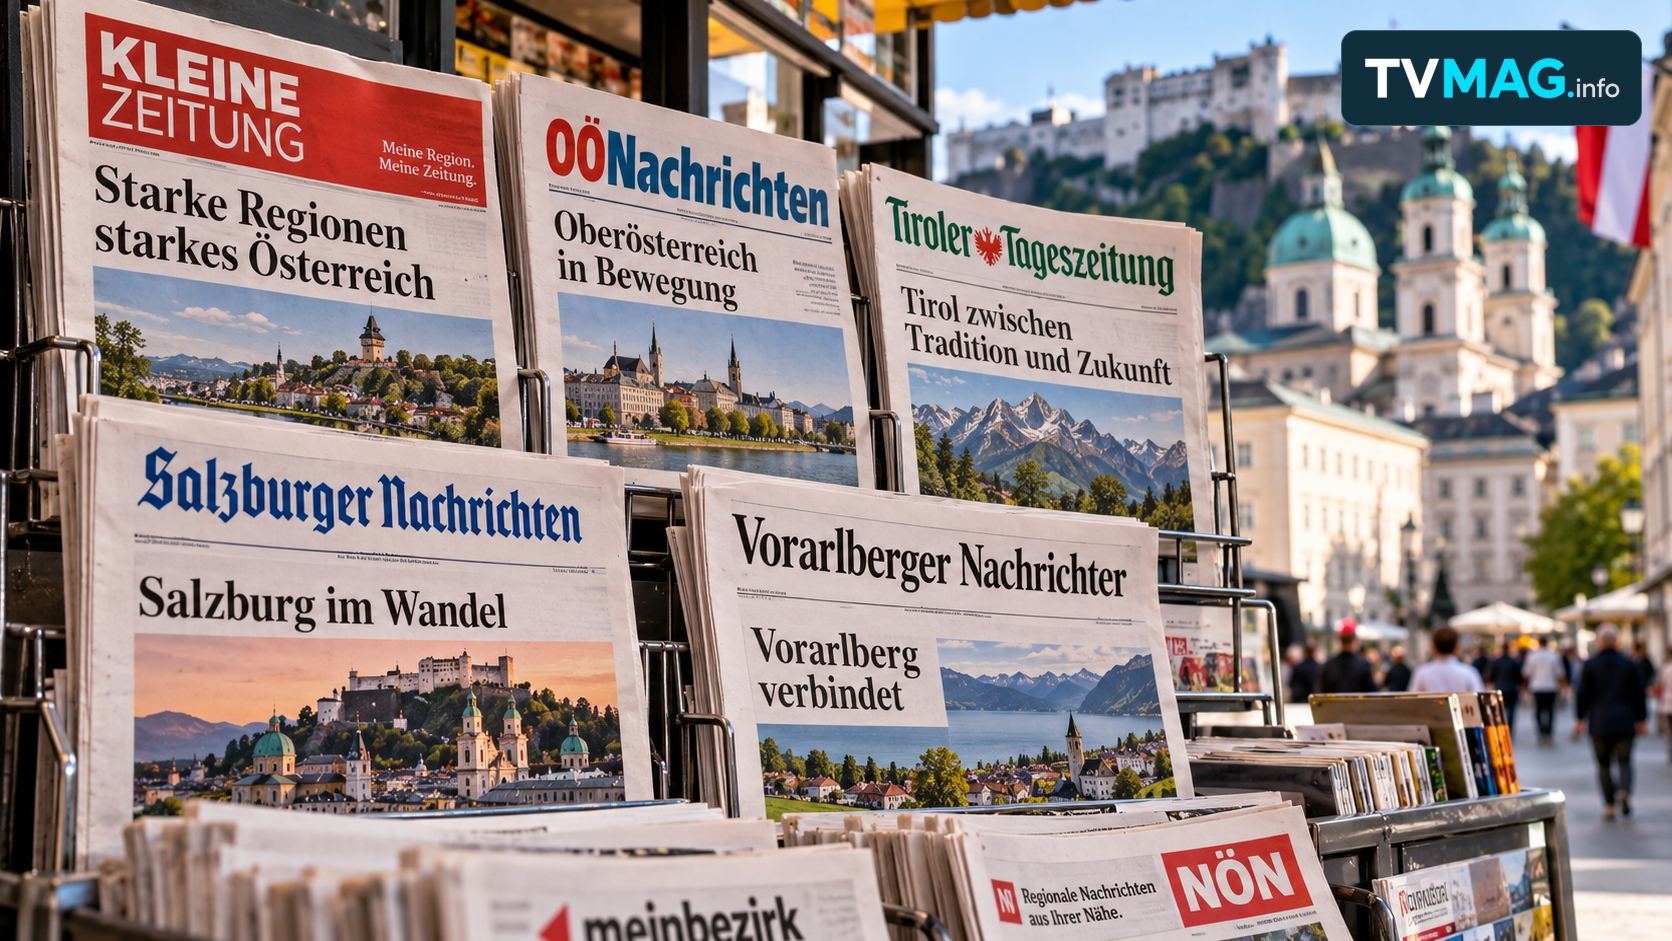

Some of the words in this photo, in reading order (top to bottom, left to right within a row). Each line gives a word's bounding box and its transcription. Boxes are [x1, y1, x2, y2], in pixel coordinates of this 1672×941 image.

[100, 30, 301, 119] KLEINE
[101, 82, 304, 163] ZEITUNG
[382, 140, 423, 160] Meine
[427, 147, 475, 168] Region.
[379, 157, 420, 176] Meine
[423, 164, 477, 188] Zeitung.
[545, 114, 830, 228] OÖNachrichten
[94, 163, 227, 223] Starke
[238, 189, 407, 253] Regionen
[95, 223, 238, 272] starkes
[248, 232, 435, 301] Österreich
[554, 209, 758, 273] Oberösterreich
[885, 195, 973, 258] Tiroler
[1000, 224, 1175, 297] Tageszeitung
[557, 249, 587, 283] in
[594, 255, 738, 312] Bewegung
[900, 285, 961, 323] Tirol
[966, 303, 1073, 341] zwischen
[904, 322, 1018, 367] Tradition
[1025, 347, 1071, 374] und
[1076, 349, 1173, 385] Zukunft
[137, 445, 373, 535] Salzburger
[378, 473, 583, 544] Nachrichten
[731, 513, 951, 593] Vorarlberger
[958, 542, 1127, 598] Nachrichter
[138, 575, 316, 633] Salzburg
[327, 586, 374, 626] im
[381, 588, 508, 629] Wandel
[750, 627, 921, 679] Vorarlberg
[758, 674, 904, 711] verbindet
[1021, 887, 1078, 908] Regionale
[1078, 881, 1157, 902] Nachrichten
[1176, 848, 1294, 913] NÖN
[582, 896, 805, 941] meinbezirk
[1029, 913, 1050, 926] aus
[1050, 909, 1082, 926] Ihrer
[1084, 905, 1123, 923] Nähe.
